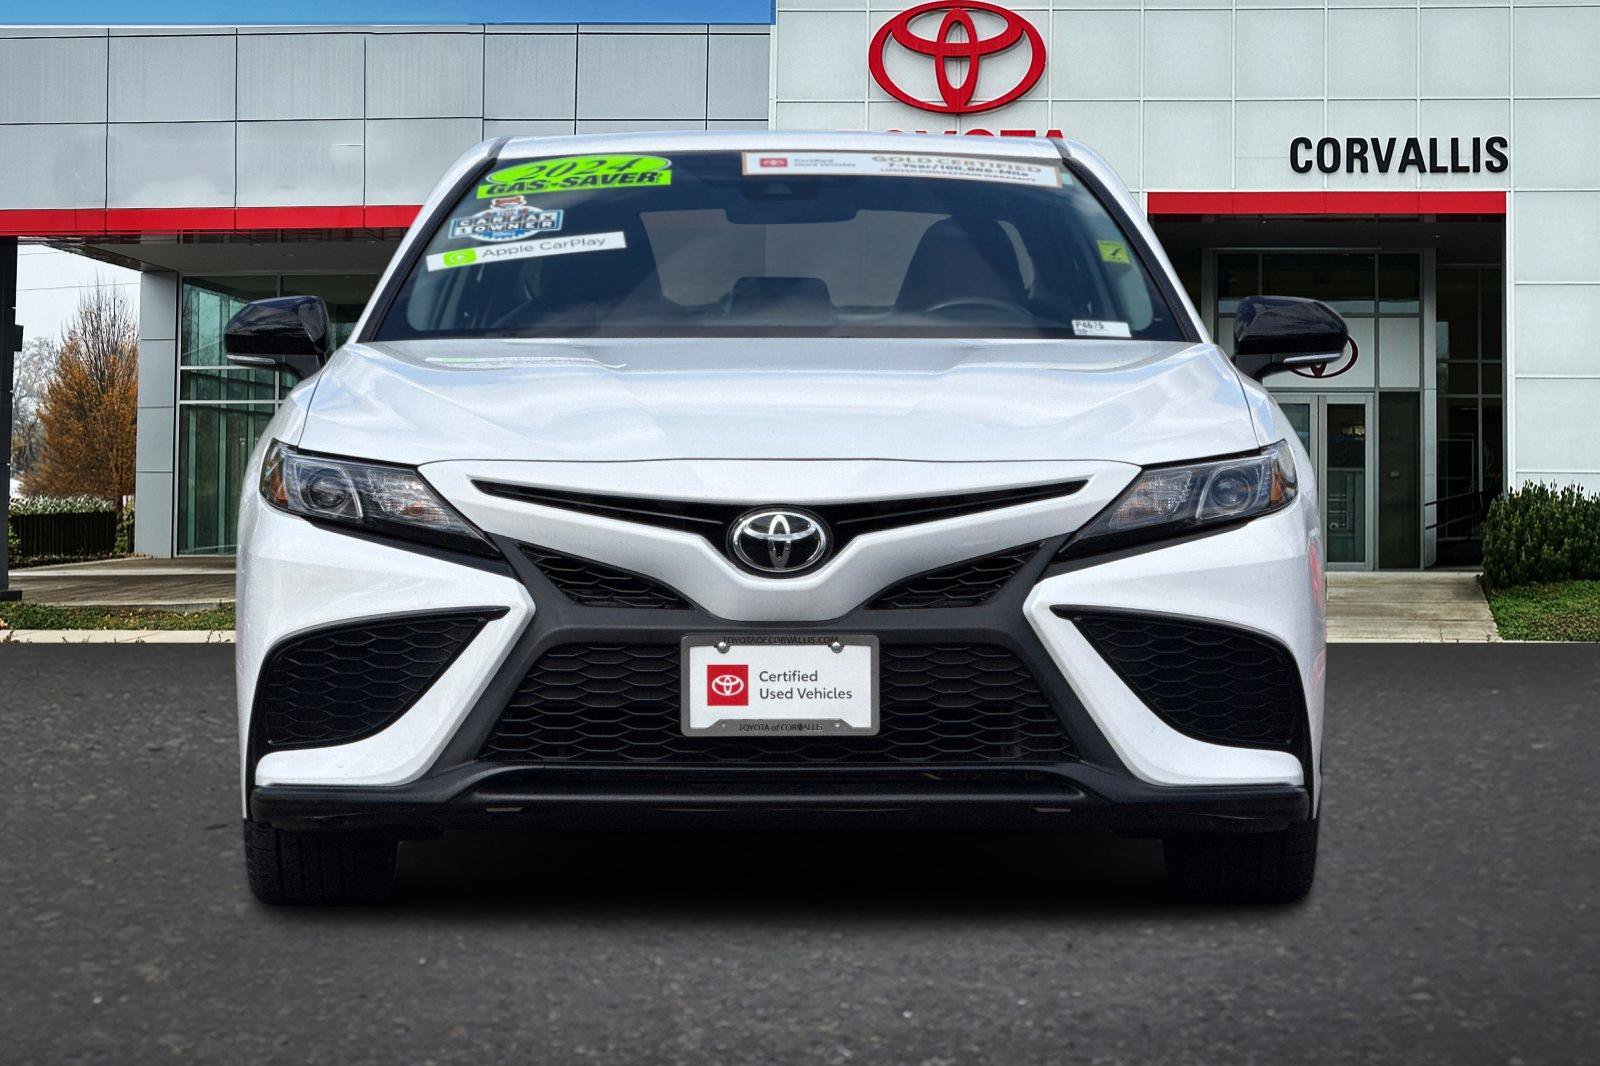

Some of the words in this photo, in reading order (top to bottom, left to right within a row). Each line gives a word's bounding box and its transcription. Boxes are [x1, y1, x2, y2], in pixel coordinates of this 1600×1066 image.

[1290, 136, 1508, 173] CORVALLIS
[516, 157, 642, 181] 2024
[459, 213, 556, 227] CARFAX
[475, 220, 553, 232] OWNER
[481, 243, 535, 259] Apple
[539, 236, 607, 252] CarPlay
[759, 670, 818, 683] Certified
[759, 688, 793, 700] Used
[797, 687, 853, 700] Vehicles
[739, 723, 770, 732] TOYOTA
[770, 723, 780, 732] of
